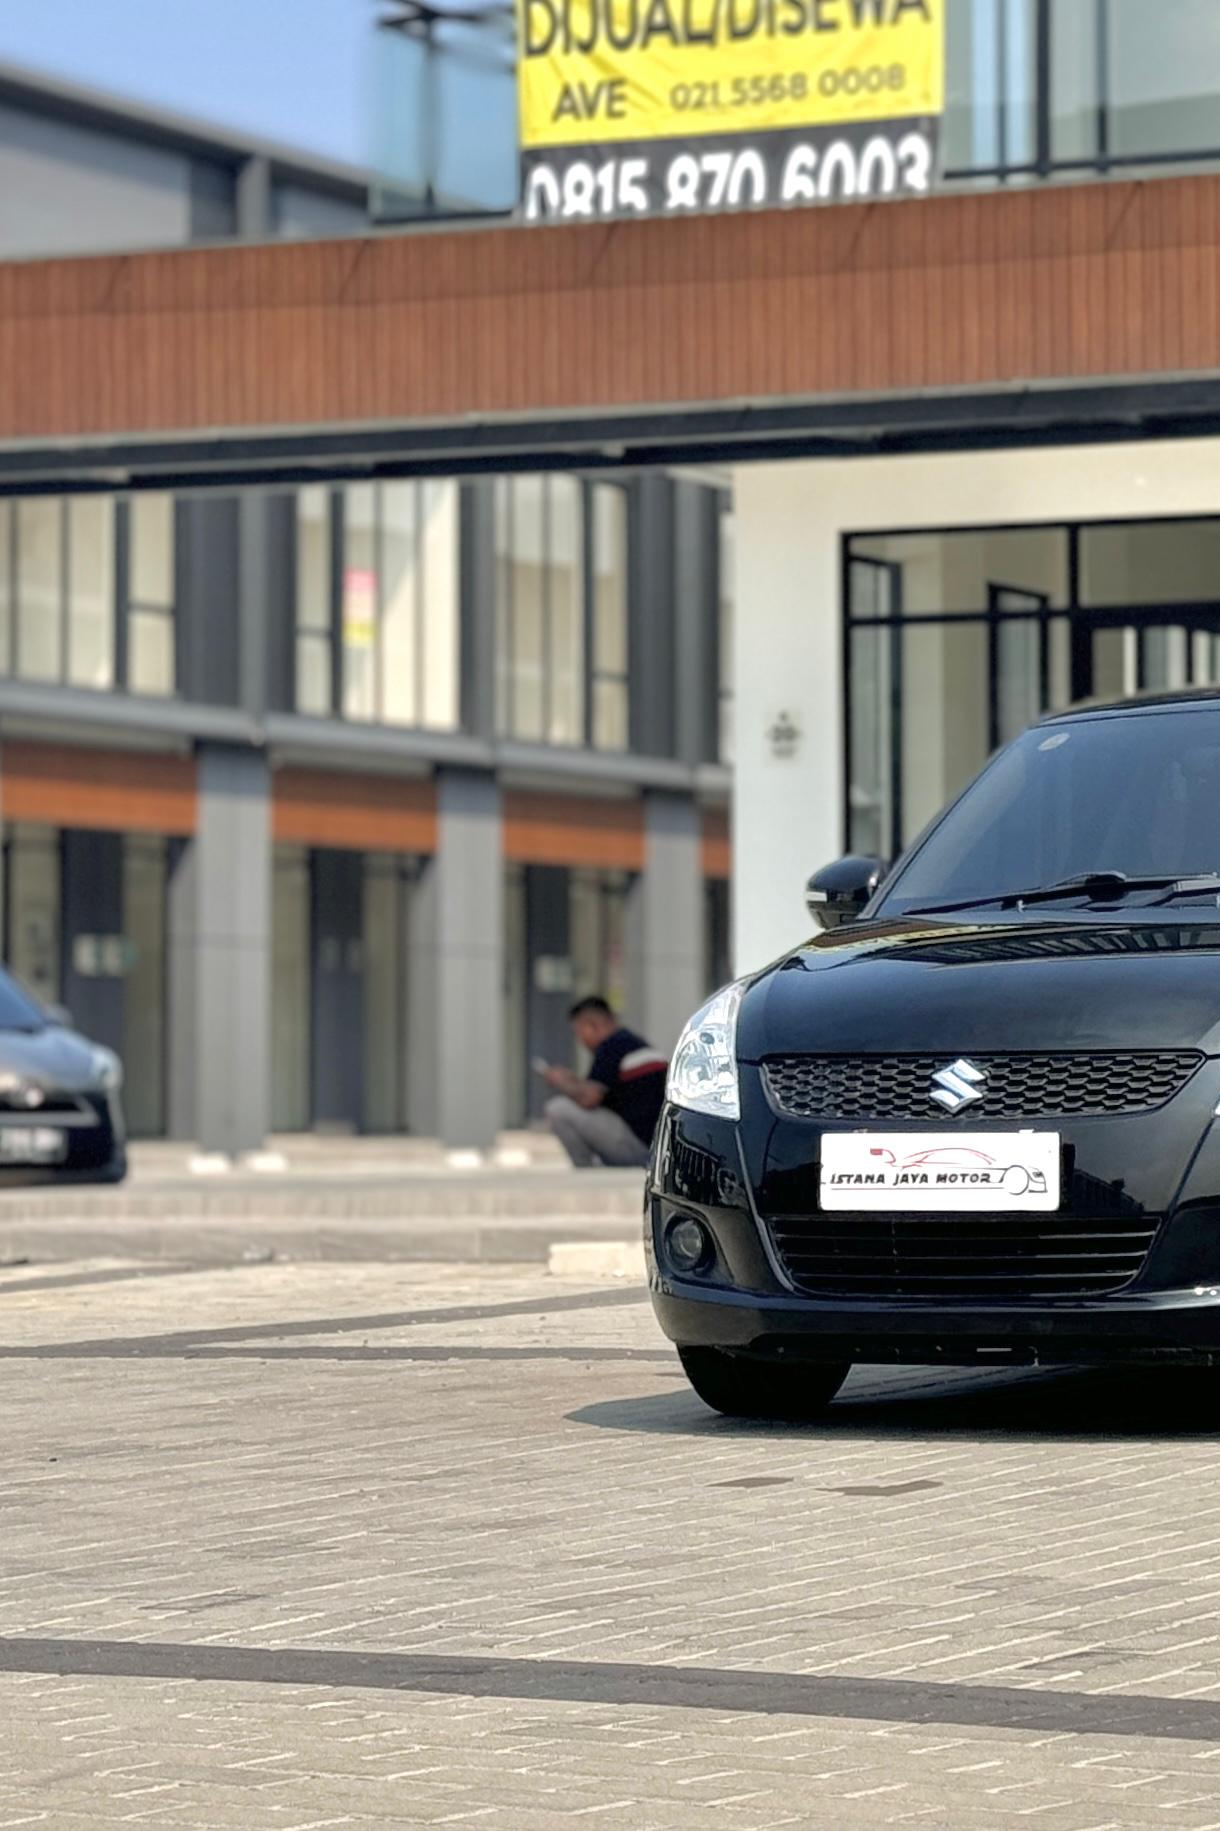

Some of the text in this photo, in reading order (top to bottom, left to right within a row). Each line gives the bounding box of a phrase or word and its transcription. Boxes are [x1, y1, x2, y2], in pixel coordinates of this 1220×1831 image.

[552, 65, 905, 122] AVE 021.5568 0008
[527, 160, 647, 218] 0815
[666, 150, 765, 209] 870
[830, 1173, 991, 1186] ISTANA JAYA MOTOR
